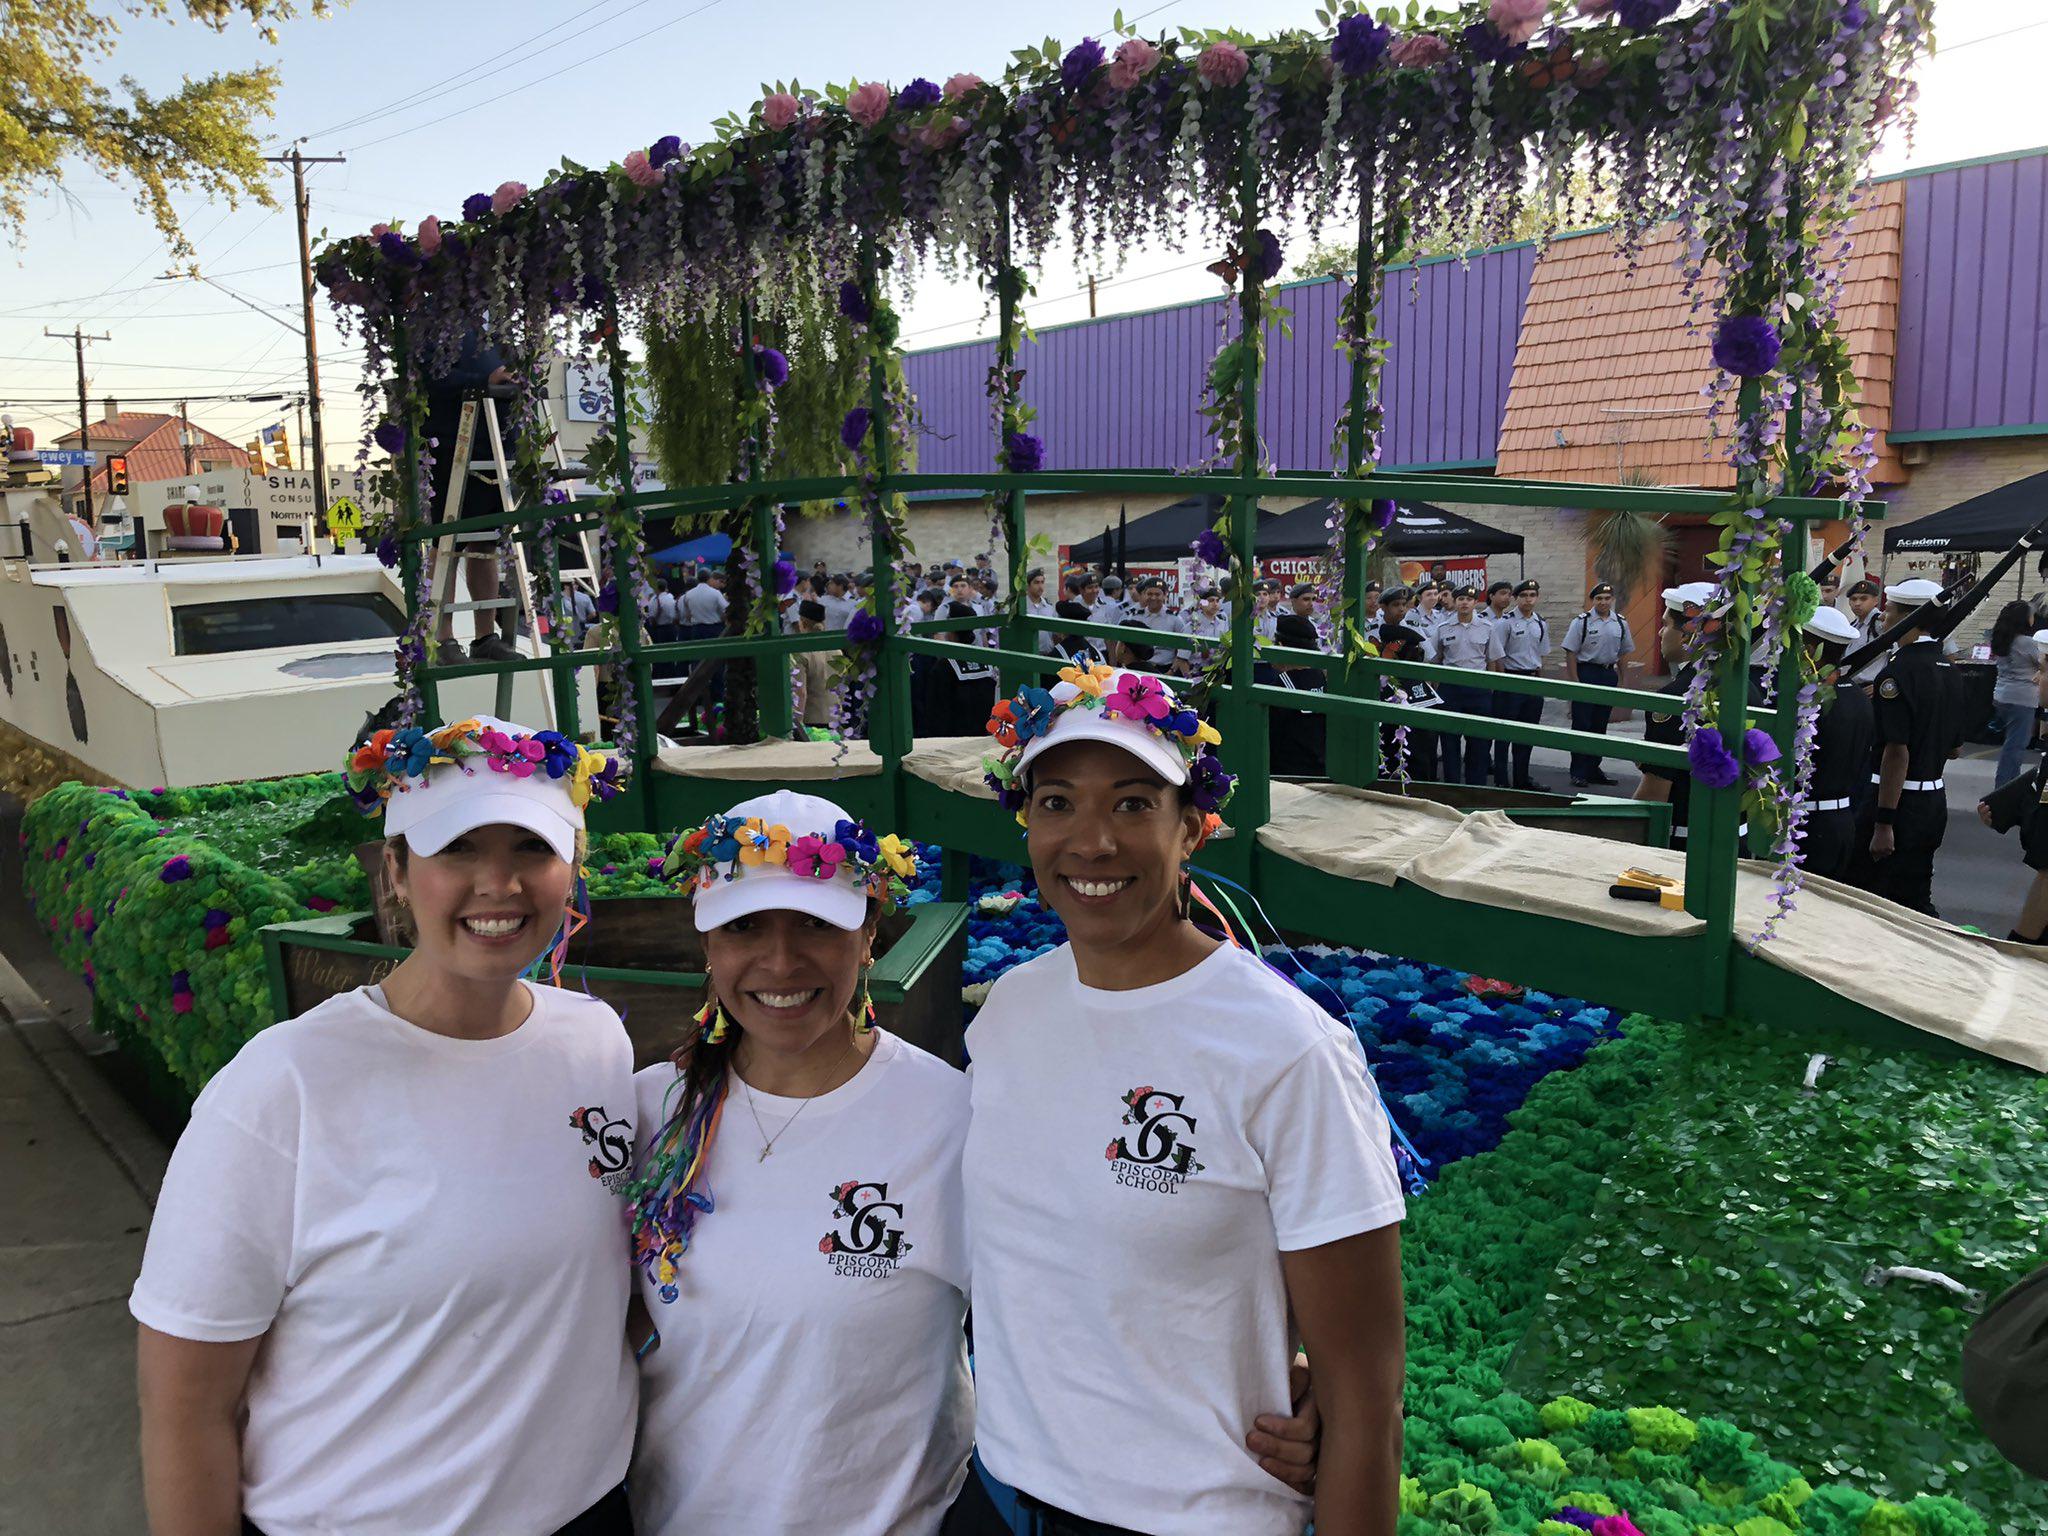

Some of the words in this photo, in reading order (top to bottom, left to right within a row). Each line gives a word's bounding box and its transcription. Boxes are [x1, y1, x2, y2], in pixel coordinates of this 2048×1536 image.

[1896, 537, 1951, 547] Academy
[1270, 560, 1328, 574] CHICKE
[1295, 573, 1310, 584] On
[1111, 1160, 1188, 1184] EPISCOPAL
[1116, 1173, 1178, 1194] SCHOOL
[828, 1254, 900, 1270] EPISCOPAL
[834, 1265, 890, 1279] SCHOOL
